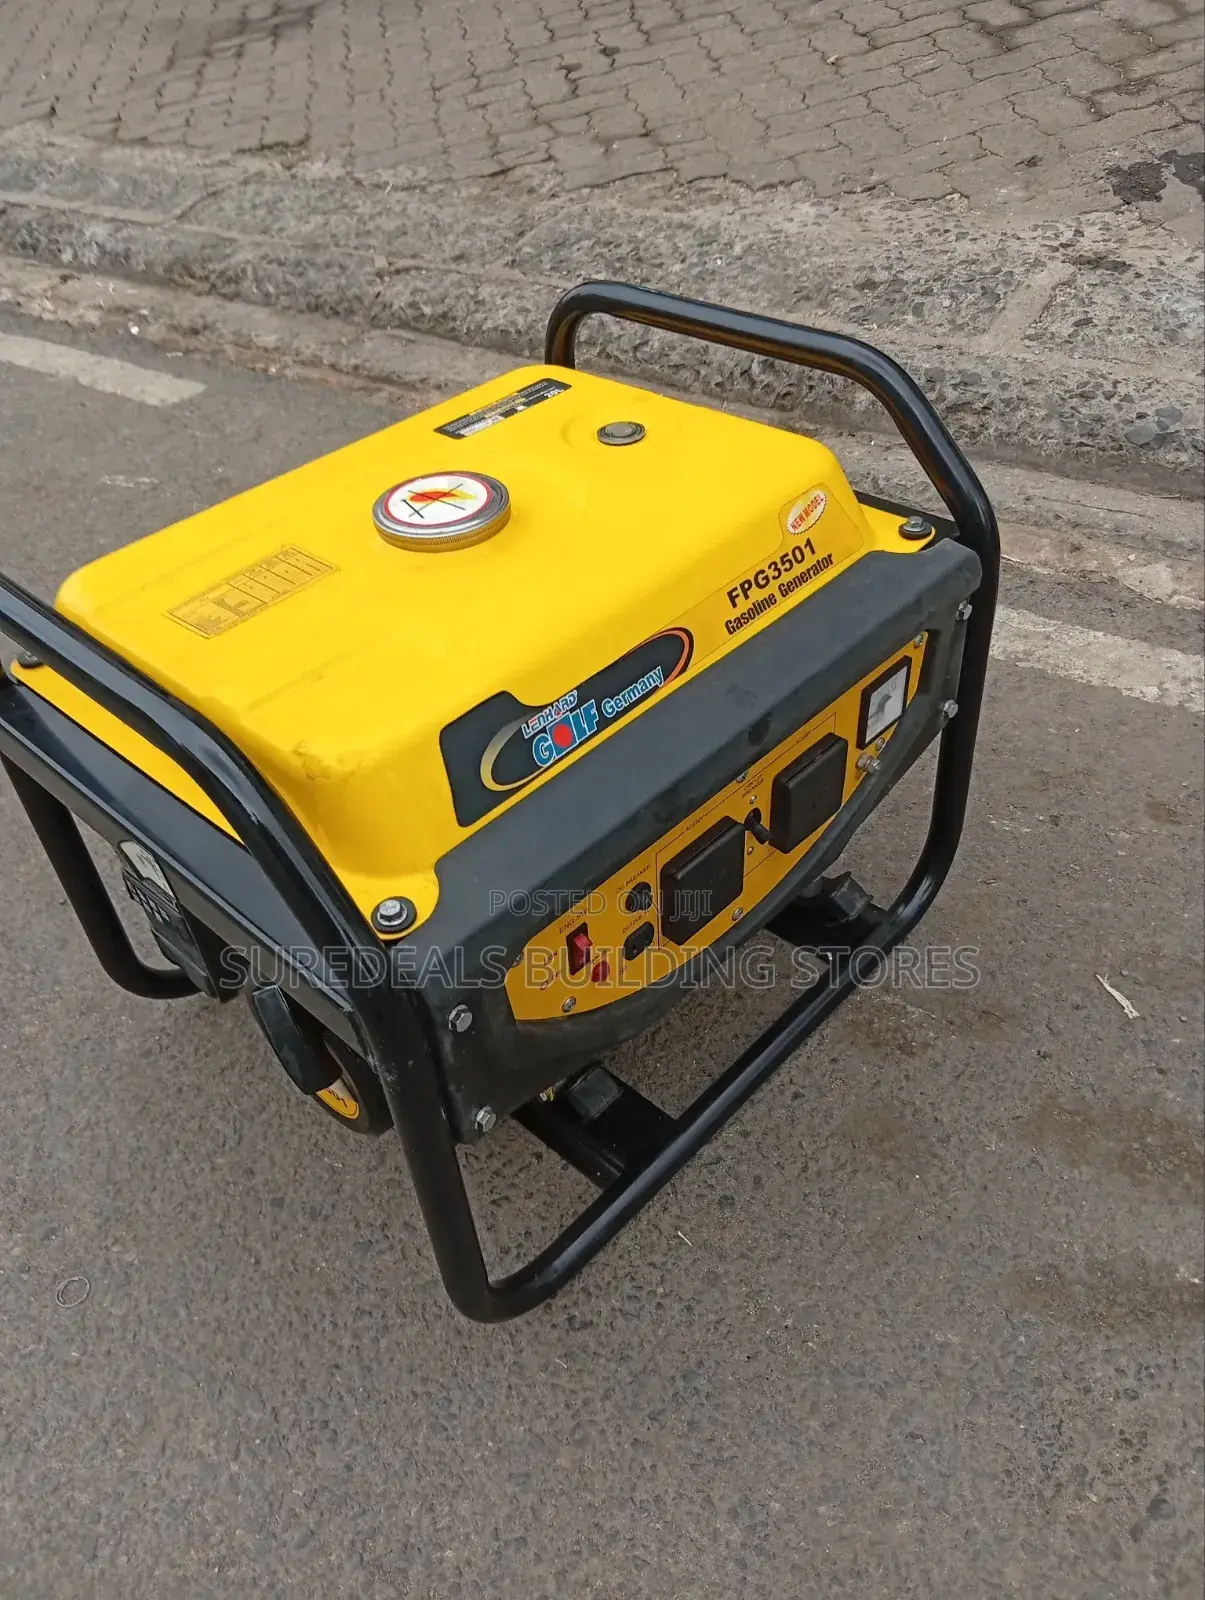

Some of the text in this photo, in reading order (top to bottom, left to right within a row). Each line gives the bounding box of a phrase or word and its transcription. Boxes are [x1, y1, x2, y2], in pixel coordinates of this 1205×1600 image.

[790, 493, 825, 532] NEW MODEL
[724, 552, 834, 636] Gasoline Generator
[726, 537, 816, 609] FPG3501
[521, 690, 578, 740] LENHARD
[532, 665, 665, 768] GOLF Germany
[625, 863, 652, 888] BREAKER
